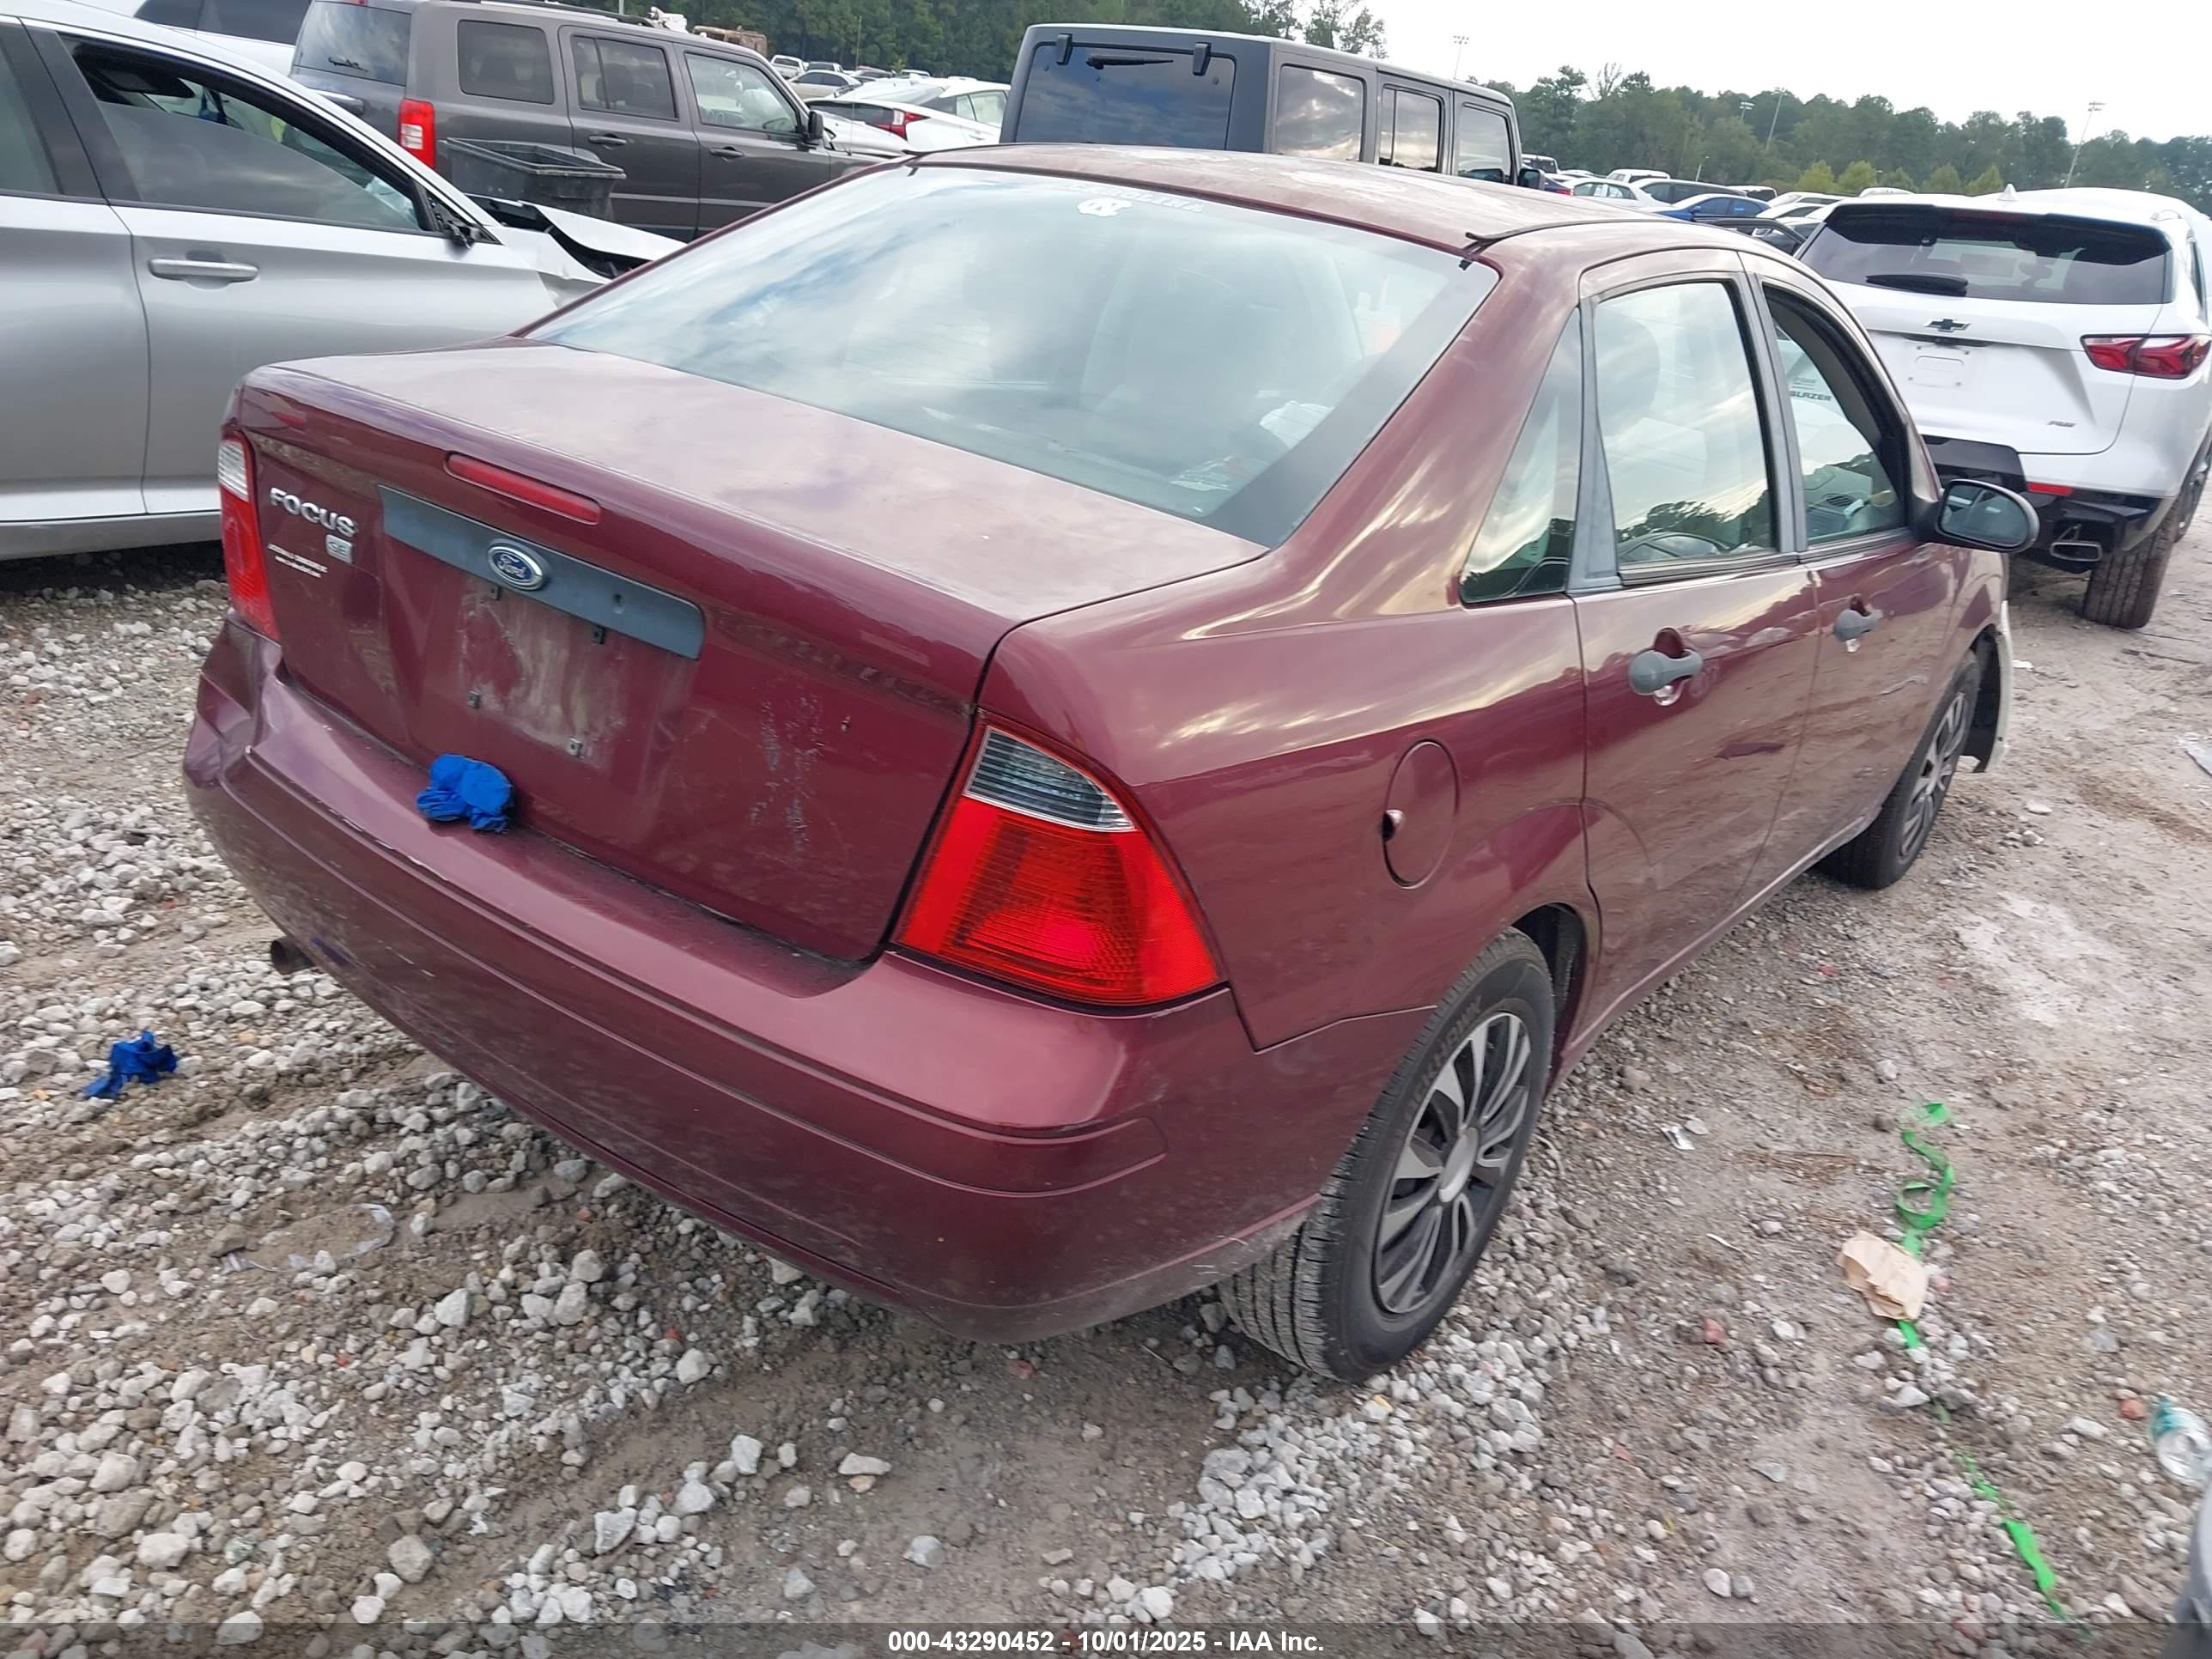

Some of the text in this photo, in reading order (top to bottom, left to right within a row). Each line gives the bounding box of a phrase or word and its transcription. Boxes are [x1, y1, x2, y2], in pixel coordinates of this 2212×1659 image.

[270, 487, 356, 538] FOCUS
[328, 540, 349, 559] SE
[497, 553, 528, 579] Ford
